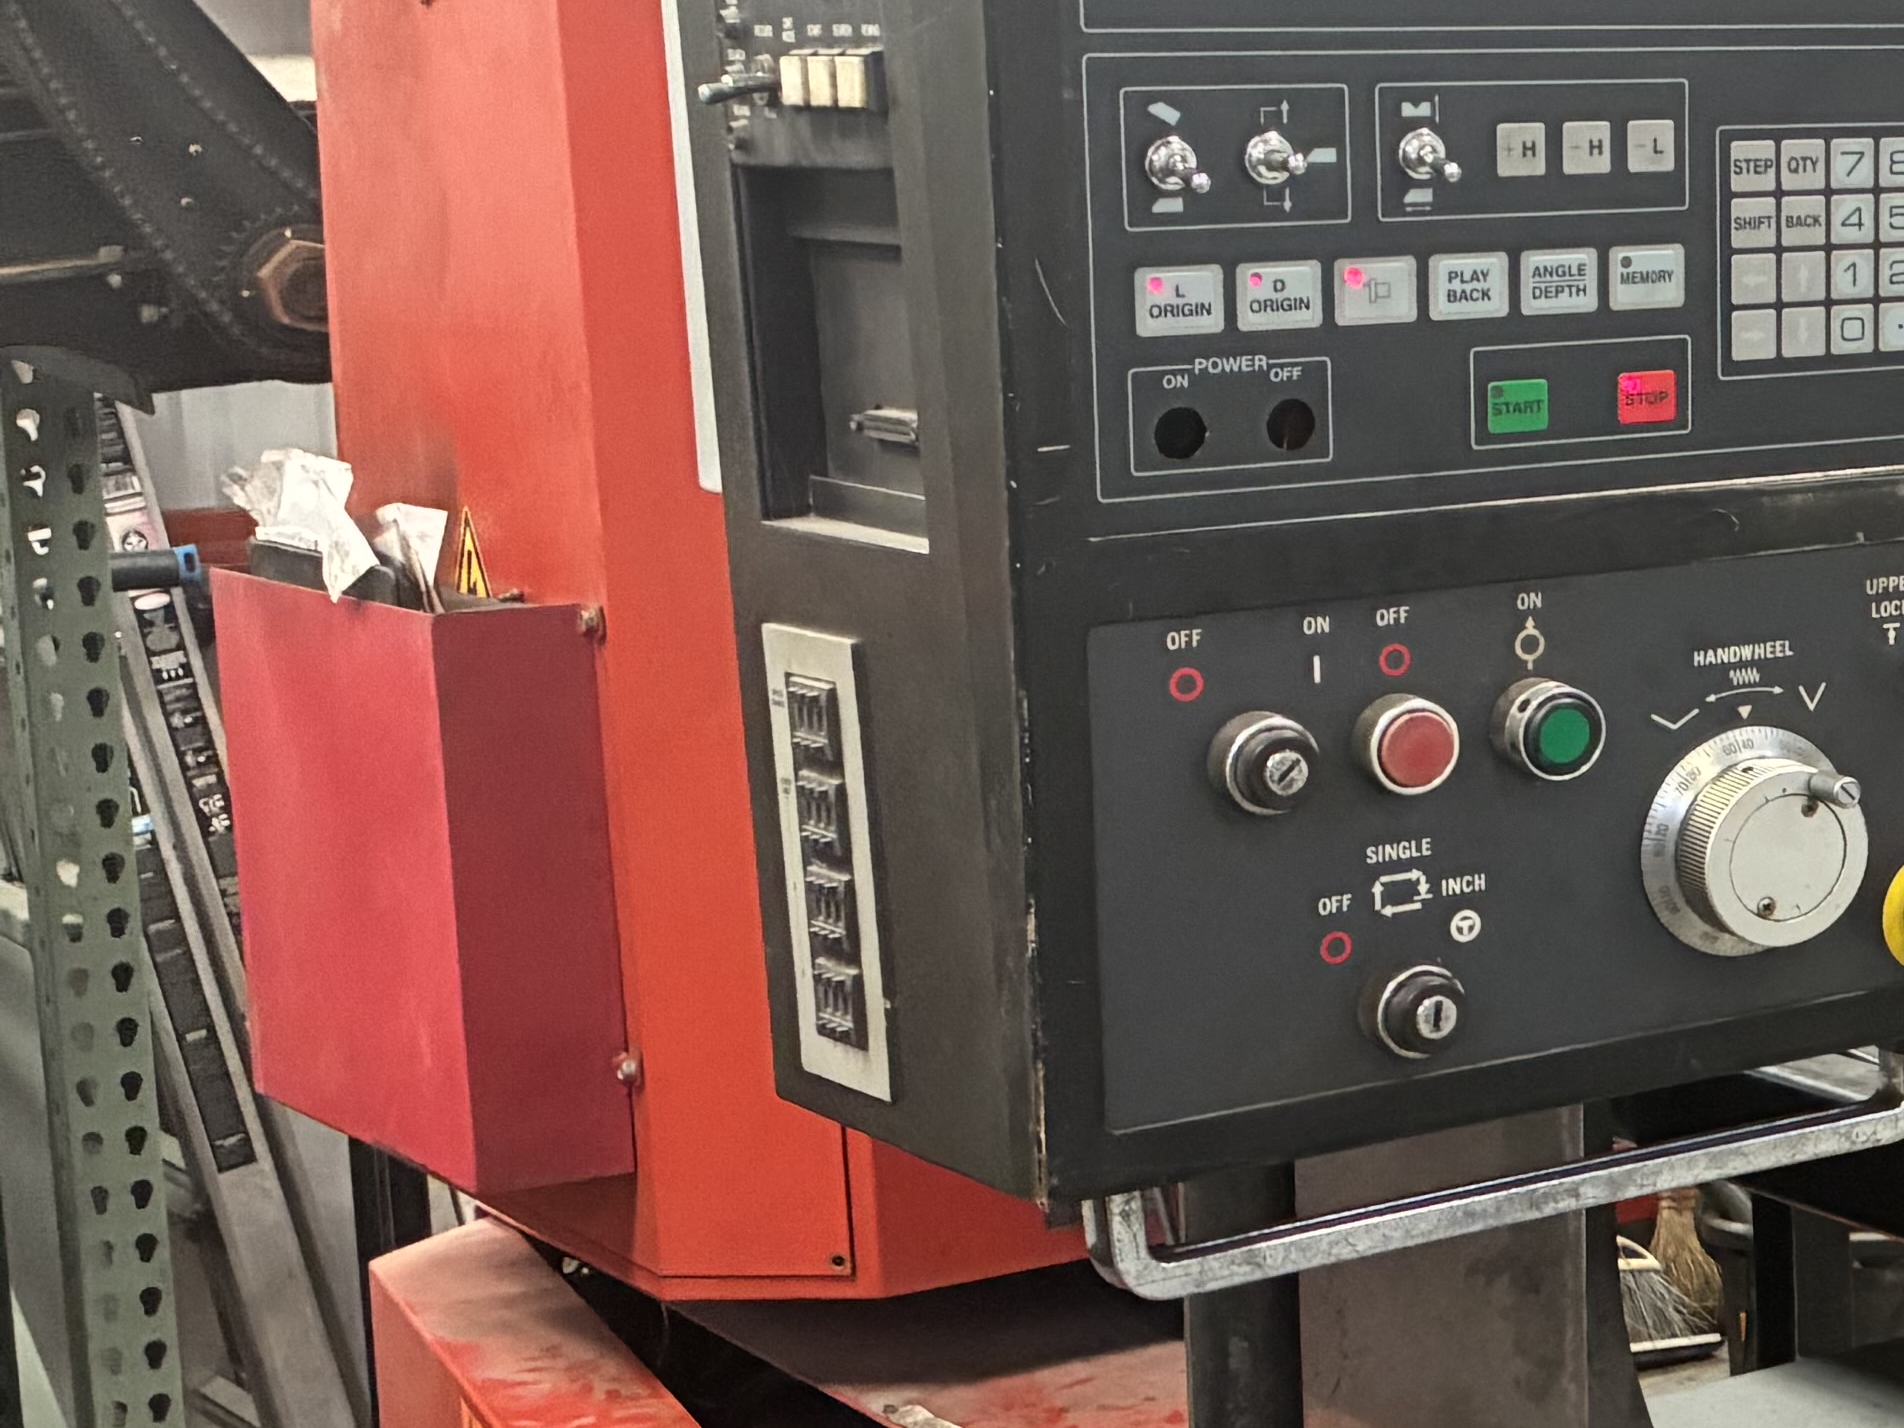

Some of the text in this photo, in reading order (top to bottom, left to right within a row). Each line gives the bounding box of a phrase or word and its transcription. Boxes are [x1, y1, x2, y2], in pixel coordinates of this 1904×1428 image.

[1733, 156, 1819, 175] STEP QTY
[1840, 150, 1865, 178] 7
[1733, 214, 1822, 231] SHIFT BACK
[1840, 206, 1865, 232] 4
[1447, 268, 1490, 288] PLAY
[1531, 262, 1588, 281] ANGLE
[1620, 268, 1674, 287] MEMORY
[1844, 261, 1857, 287] 1
[1273, 278, 1286, 294] D
[1446, 285, 1492, 306] BACK
[1531, 282, 1587, 302] DEPTH
[1148, 300, 1212, 321] ORIGIN
[1249, 295, 1311, 316] ORIGIN
[1194, 356, 1268, 375] POWER
[1270, 366, 1303, 384] OFF
[1162, 374, 1189, 391] ON
[1491, 398, 1545, 417] START
[1624, 389, 1670, 409] STOP
[1516, 591, 1543, 610] ON
[1303, 615, 1330, 635] ON
[1375, 606, 1410, 627] OFF
[1166, 629, 1202, 651] OFF
[1693, 640, 1794, 667] HANDWHEEL
[1366, 837, 1432, 864] SINGLE
[1441, 873, 1486, 896] INCH
[1318, 894, 1352, 916] OFF
